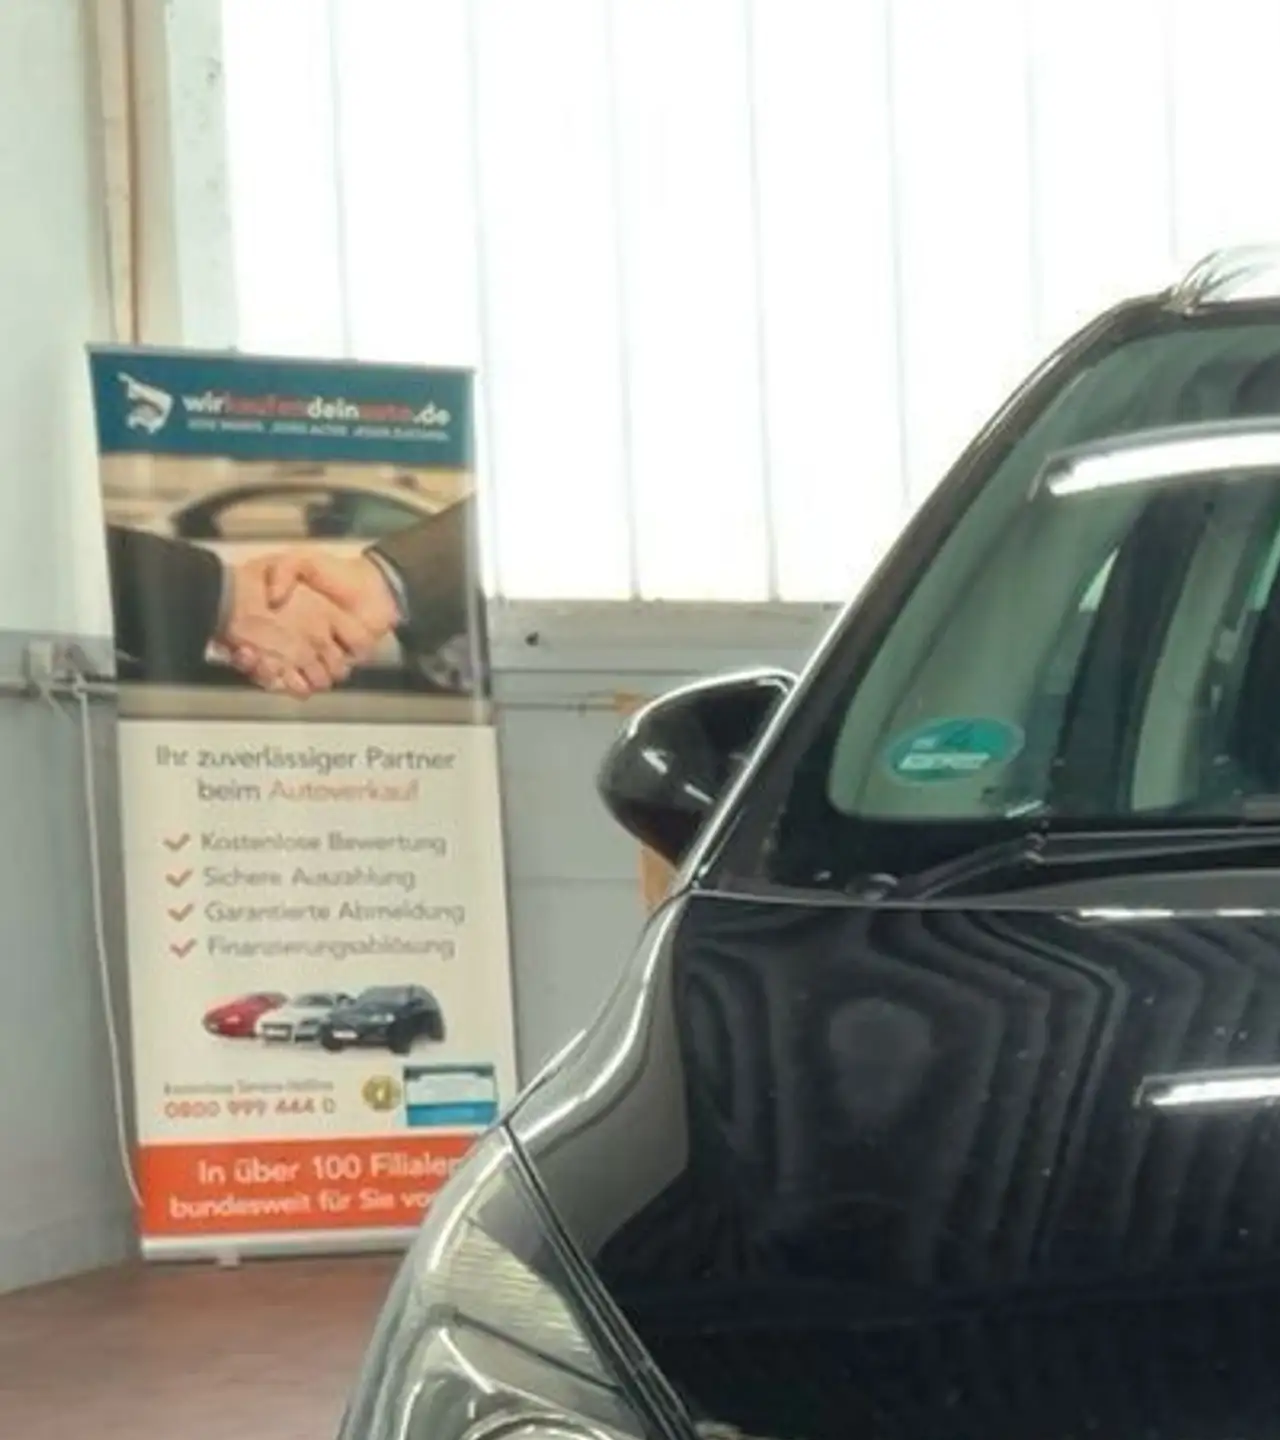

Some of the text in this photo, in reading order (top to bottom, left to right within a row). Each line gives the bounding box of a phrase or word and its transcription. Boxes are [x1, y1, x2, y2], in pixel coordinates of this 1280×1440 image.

[156, 745, 456, 774] Ihr zuverlässiger Partner
[197, 779, 261, 801] beim
[198, 1158, 227, 1185] In
[233, 1155, 300, 1184] über
[312, 1152, 362, 1180] 100
[168, 1187, 436, 1219] bundesweit für Sie vo
